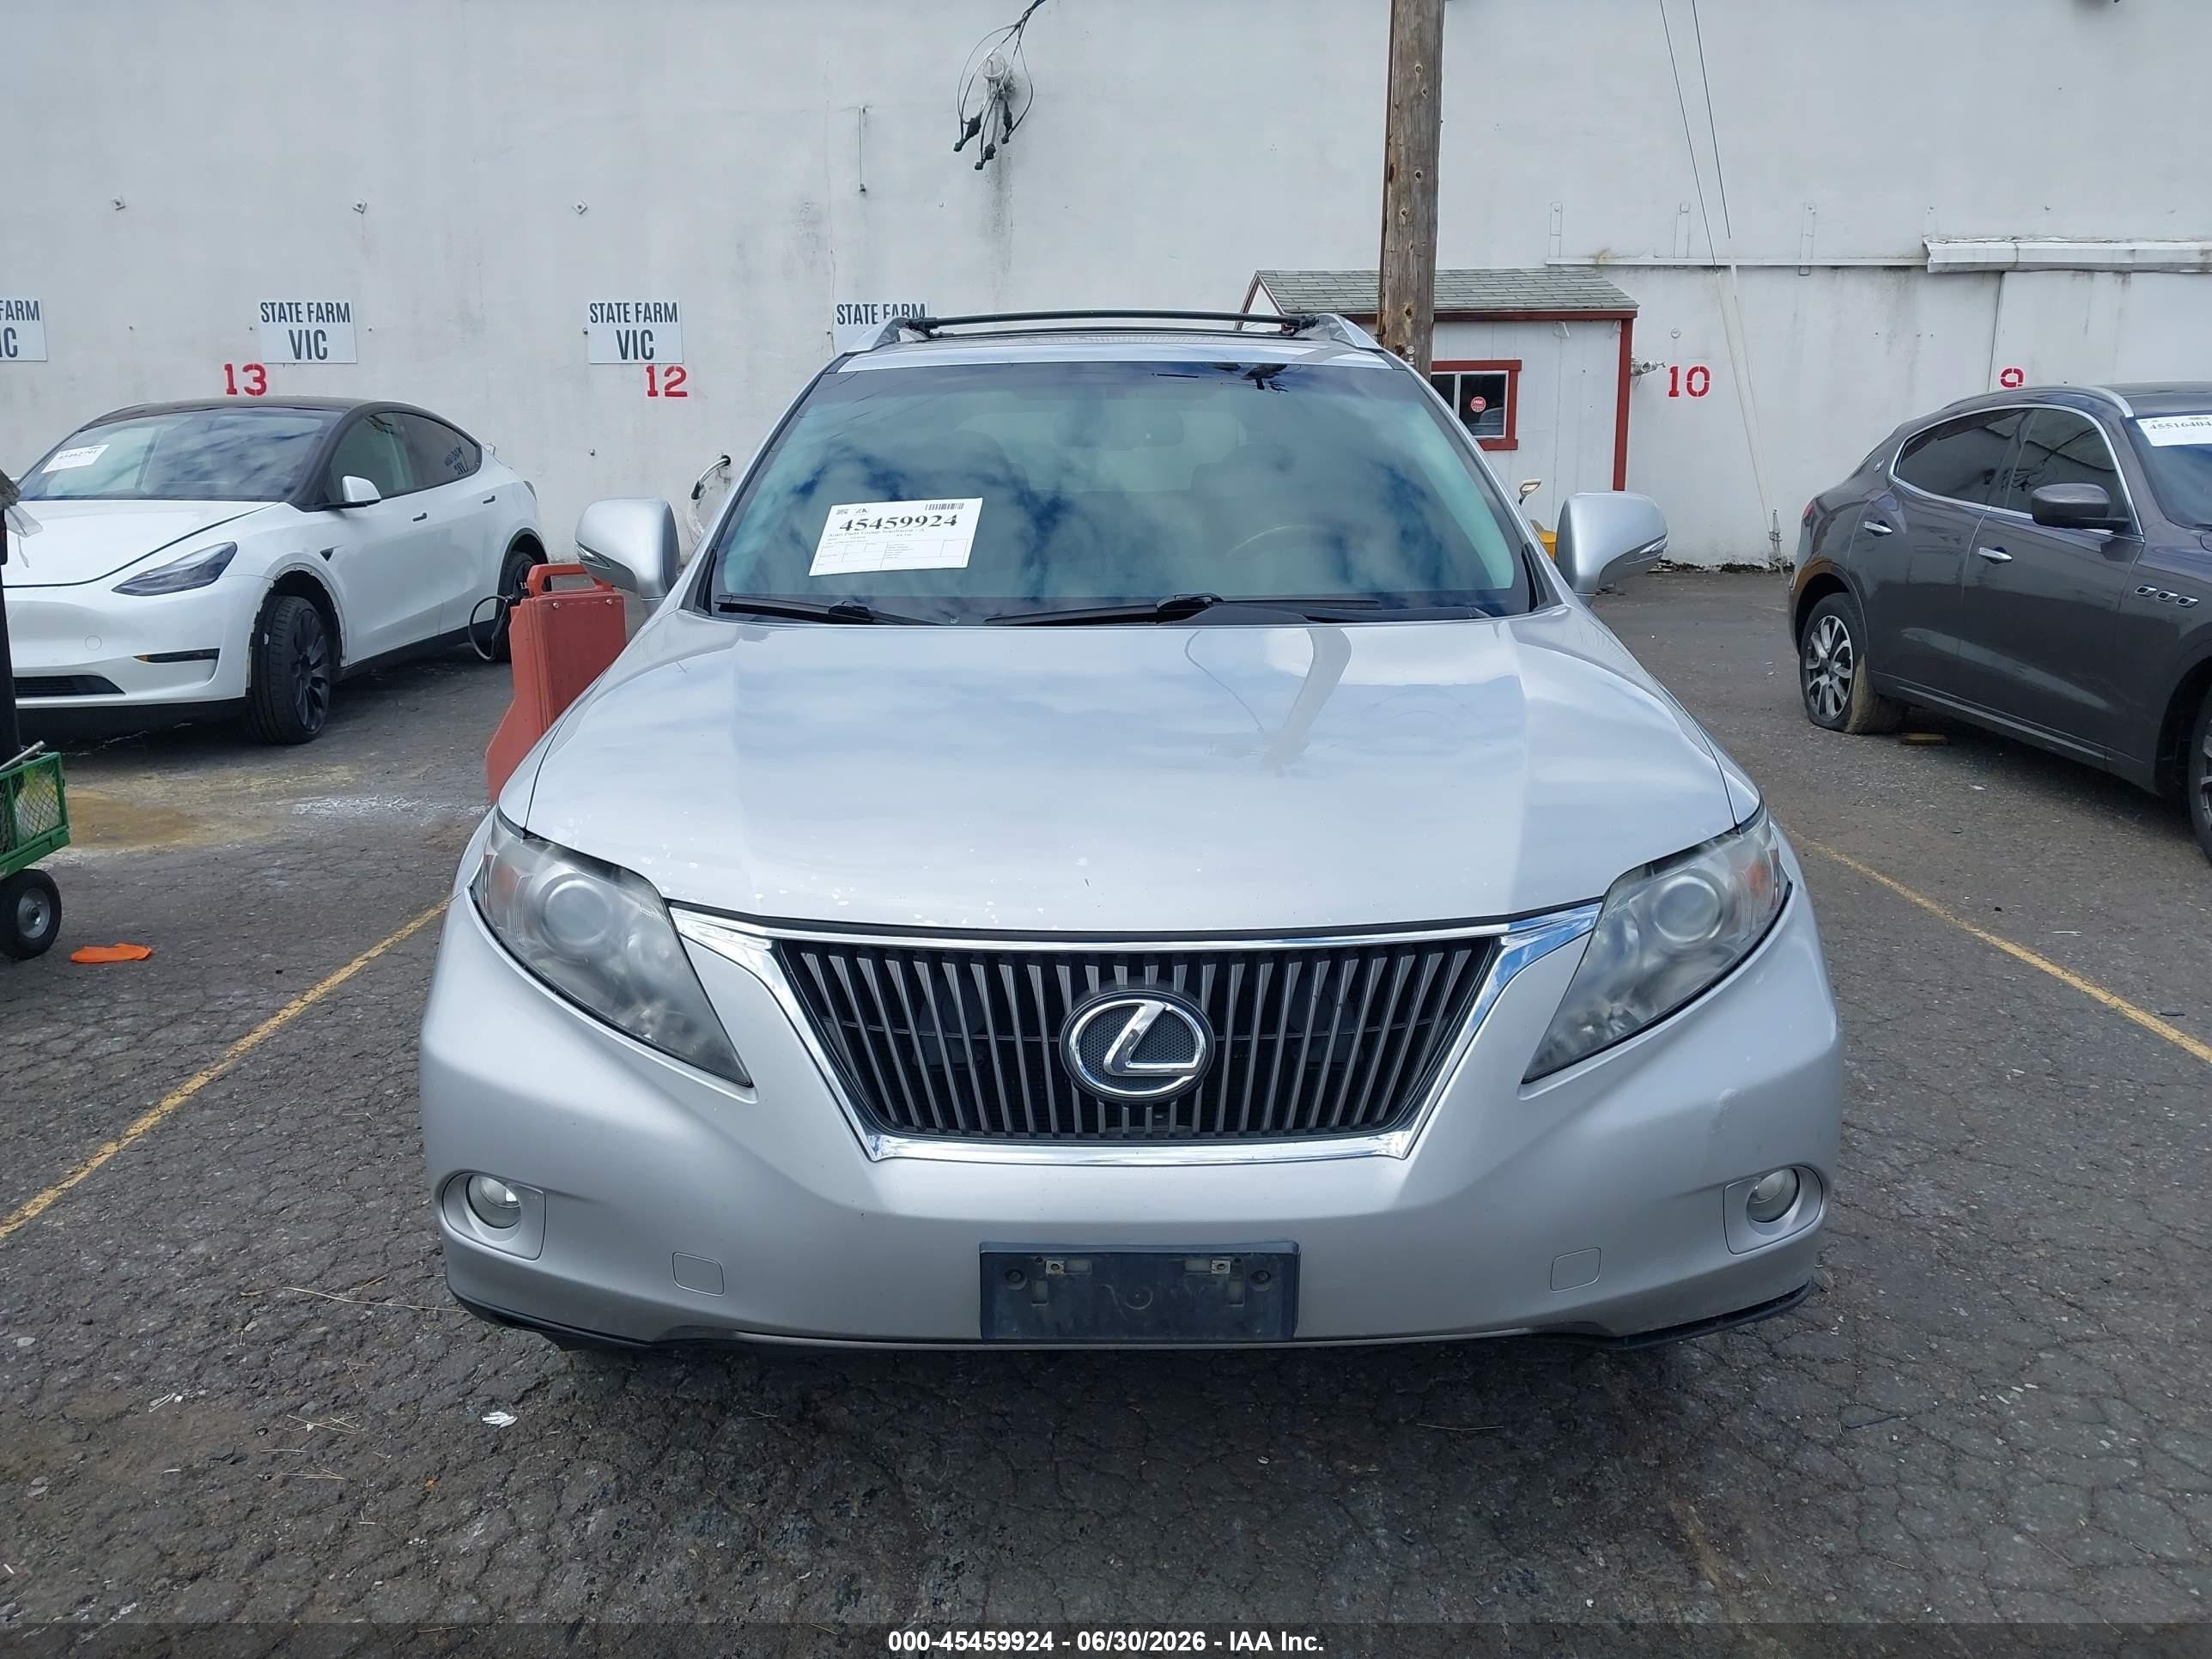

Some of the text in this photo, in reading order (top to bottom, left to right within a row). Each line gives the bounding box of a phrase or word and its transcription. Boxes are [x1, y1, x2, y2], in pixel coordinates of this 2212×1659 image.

[260, 302, 350, 323] STATE FARM
[589, 301, 678, 323] STATE FARM
[836, 303, 879, 325] STATE
[288, 329, 328, 360] VIC
[615, 329, 654, 360] VIC
[224, 363, 267, 397] 13
[646, 366, 688, 397] 12
[1668, 366, 1710, 397] 10
[839, 514, 958, 532] 45459924
